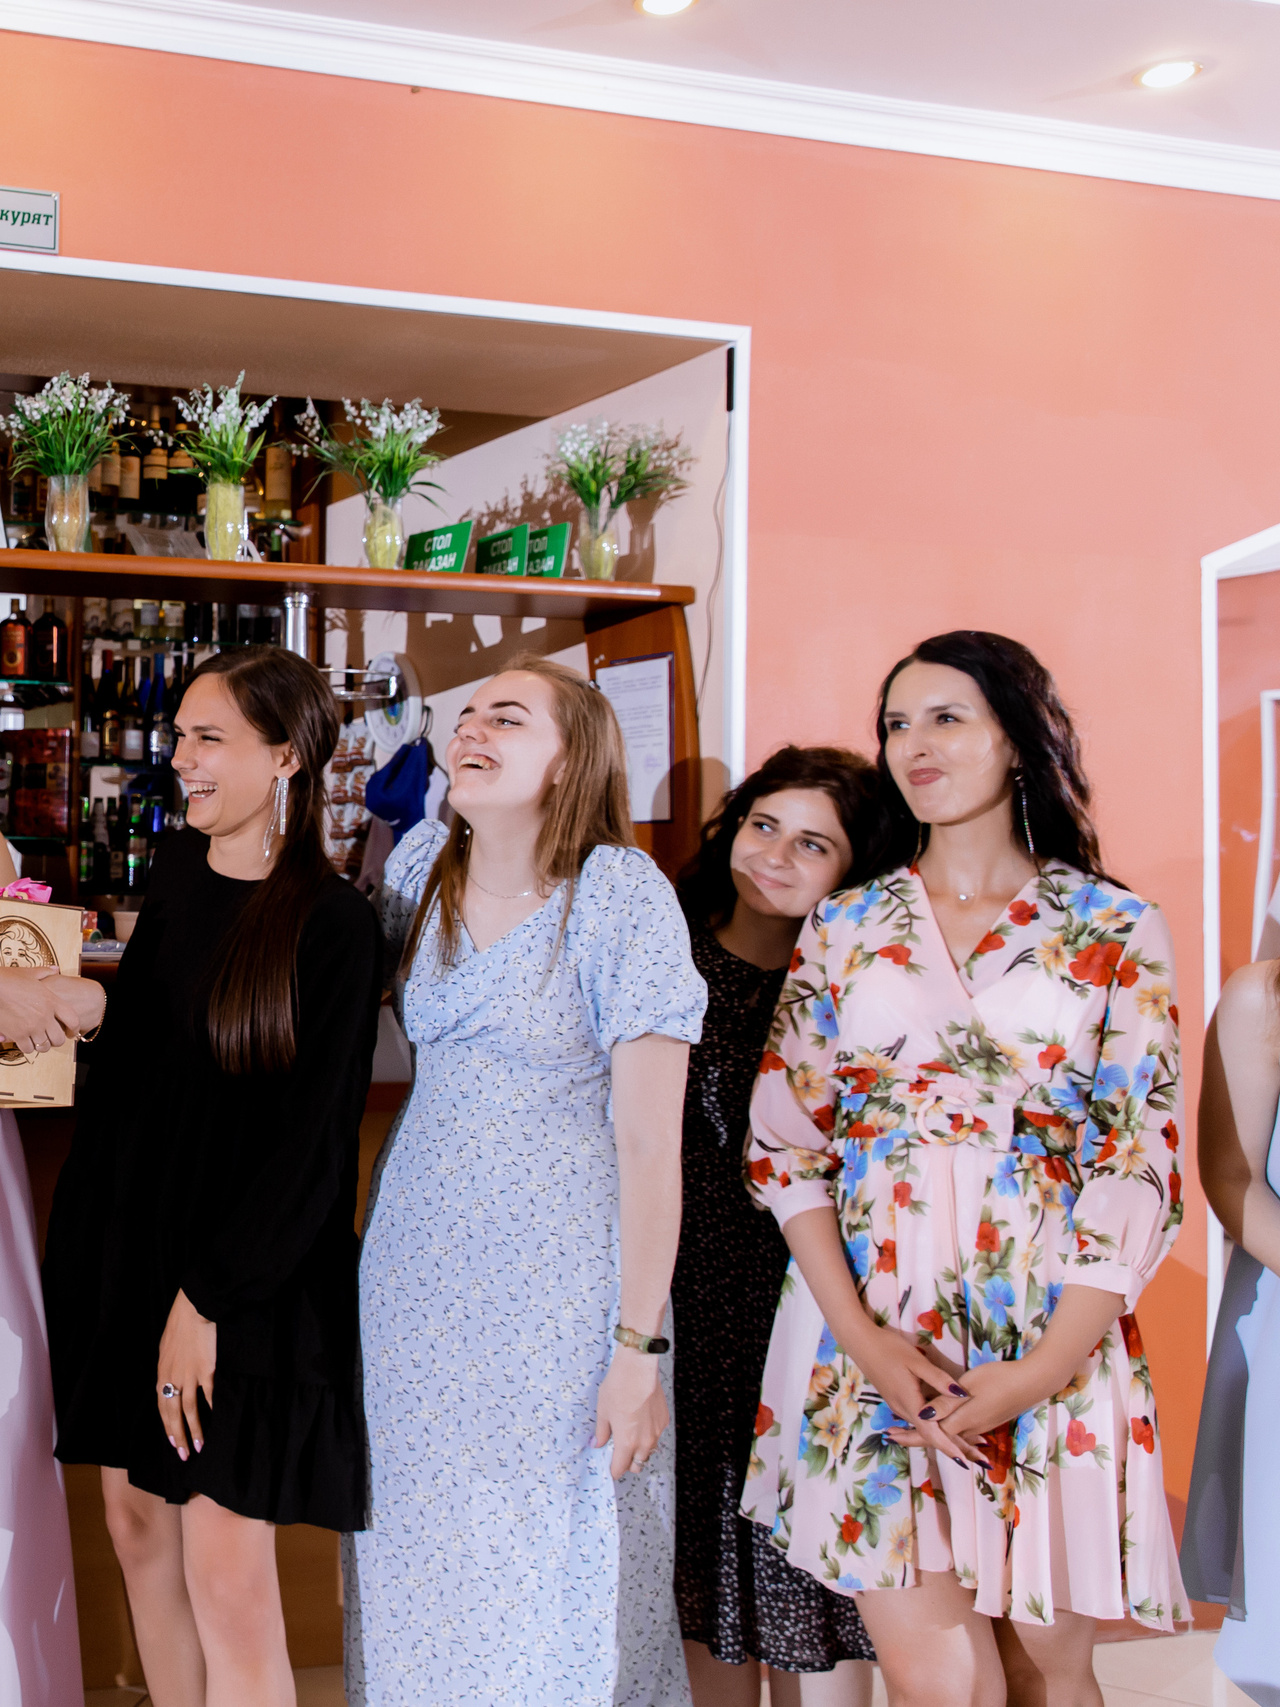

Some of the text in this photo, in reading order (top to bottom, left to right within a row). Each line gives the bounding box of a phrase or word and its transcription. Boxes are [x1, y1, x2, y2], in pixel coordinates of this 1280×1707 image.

[0, 210, 53, 226] курят
[424, 533, 453, 553] СТОЛ
[490, 537, 513, 557] СТОЛ
[528, 536, 548, 553] ТОЛ
[528, 555, 555, 574] АЗАН
